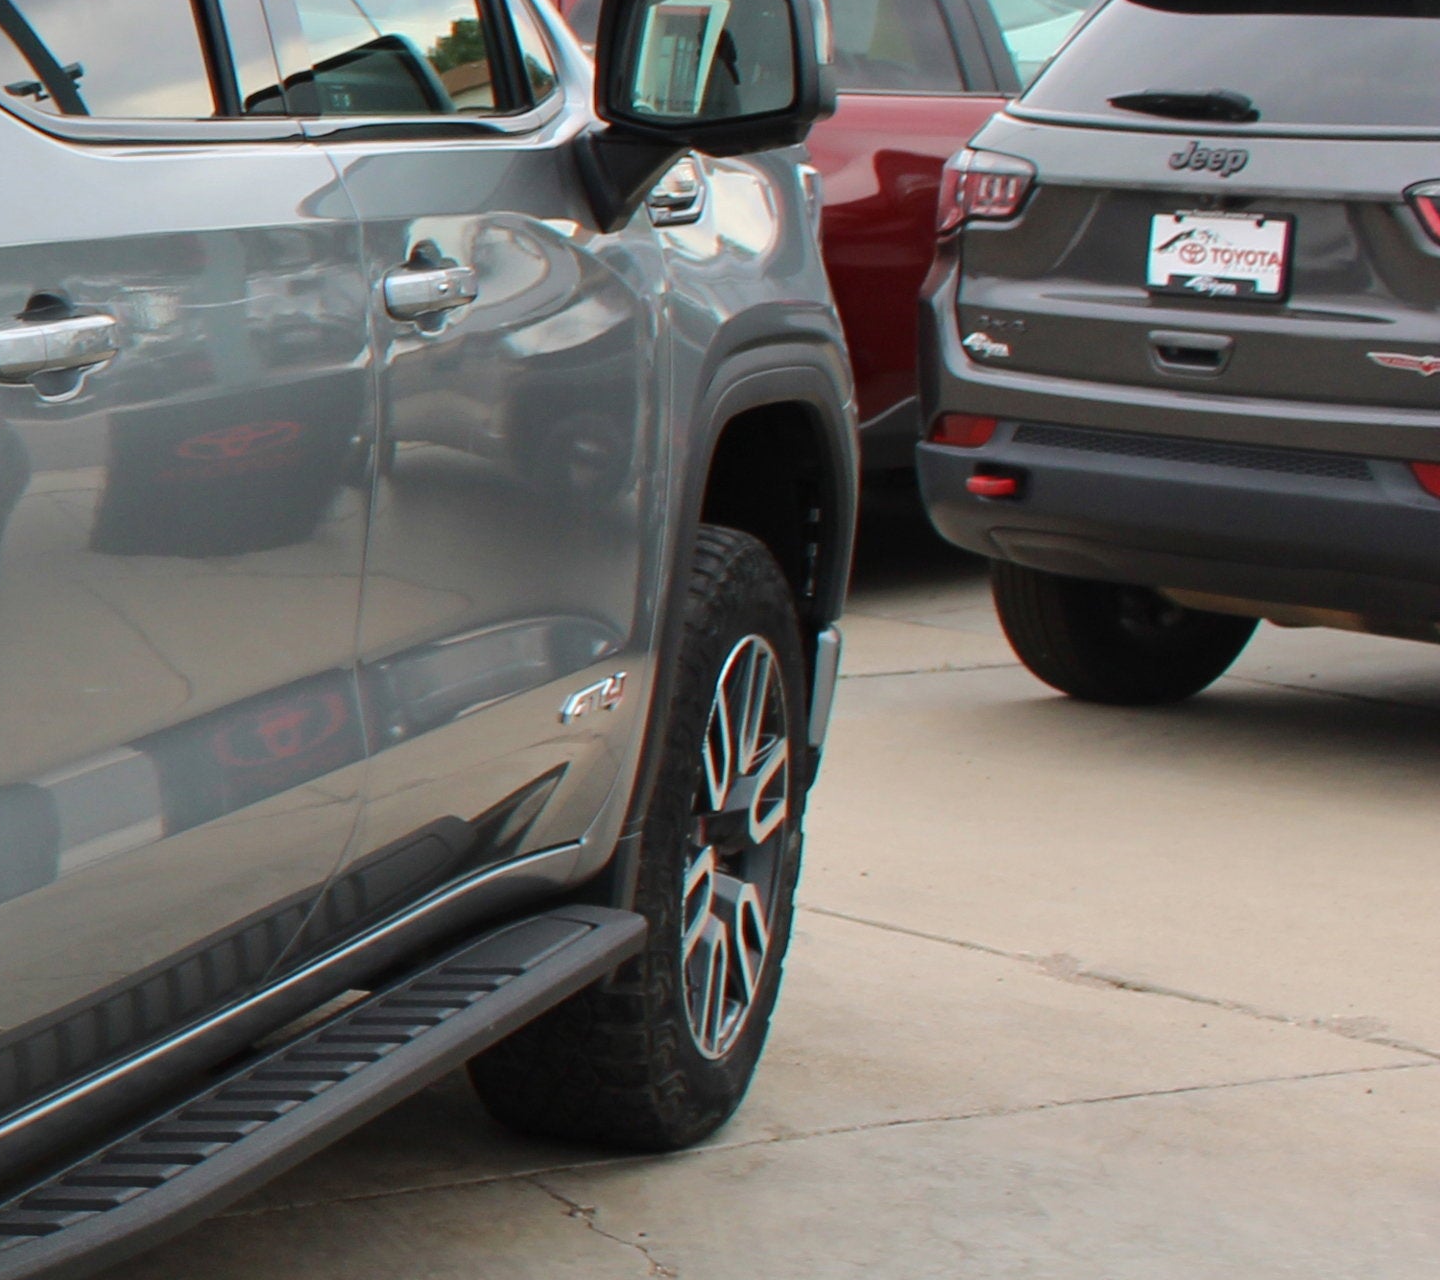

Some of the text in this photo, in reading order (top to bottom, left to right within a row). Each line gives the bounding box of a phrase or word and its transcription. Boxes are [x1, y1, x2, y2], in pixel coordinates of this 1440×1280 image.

[1169, 141, 1249, 178] Jeep
[1211, 248, 1281, 267] TOYOTA
[560, 671, 627, 724] AT4
